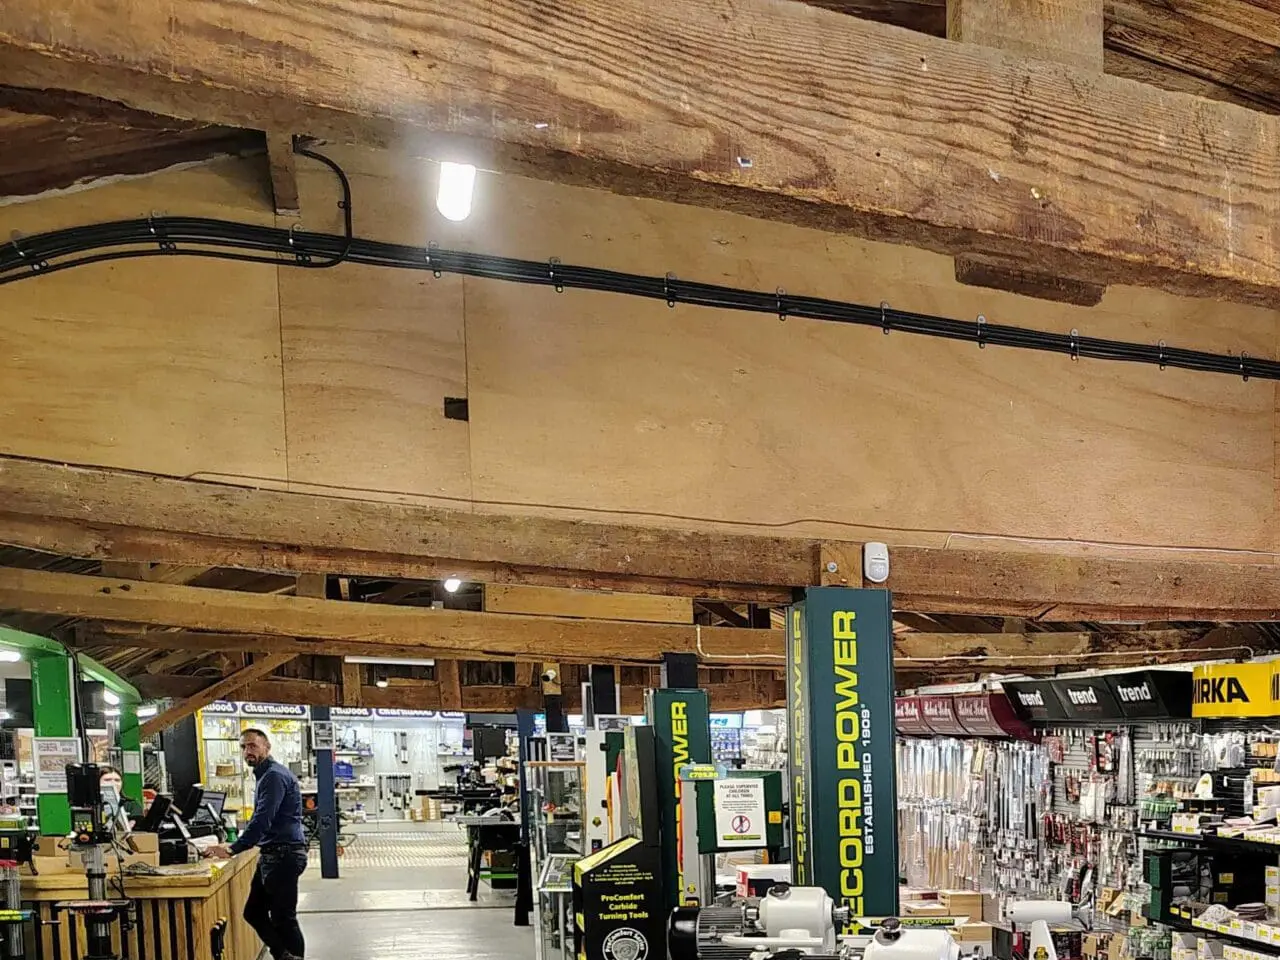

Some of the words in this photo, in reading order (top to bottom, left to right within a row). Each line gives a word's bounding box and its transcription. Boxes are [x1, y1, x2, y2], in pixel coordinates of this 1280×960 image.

[833, 610, 860, 769] POWER
[1017, 690, 1042, 706] trend
[1067, 687, 1097, 704] trend
[1117, 682, 1151, 701] trend
[861, 707, 871, 746] 1909
[863, 752, 874, 854] ESTABLISHED
[629, 911, 649, 919] Tools
